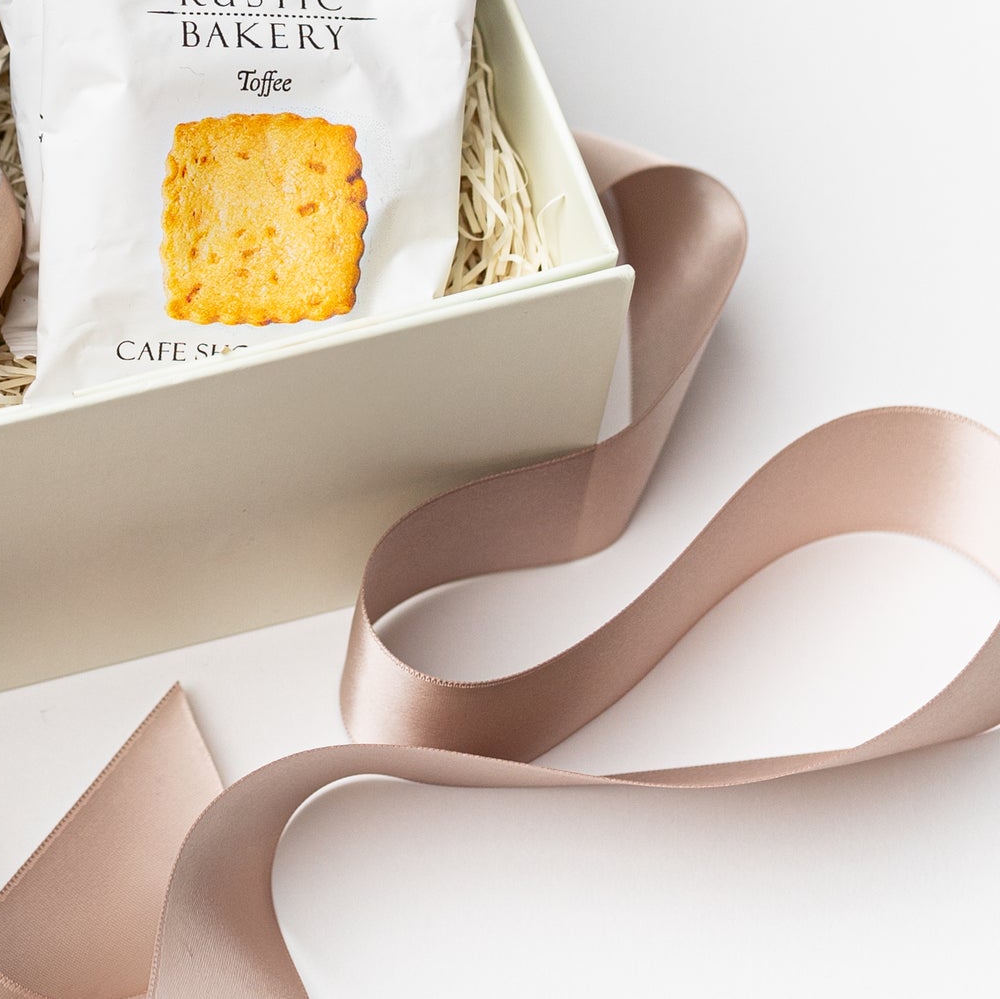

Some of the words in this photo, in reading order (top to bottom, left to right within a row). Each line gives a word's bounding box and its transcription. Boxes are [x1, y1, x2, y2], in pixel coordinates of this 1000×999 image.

[181, 20, 344, 50] BAKERY
[237, 69, 292, 97] Toffee
[116, 340, 187, 362] CAFE
